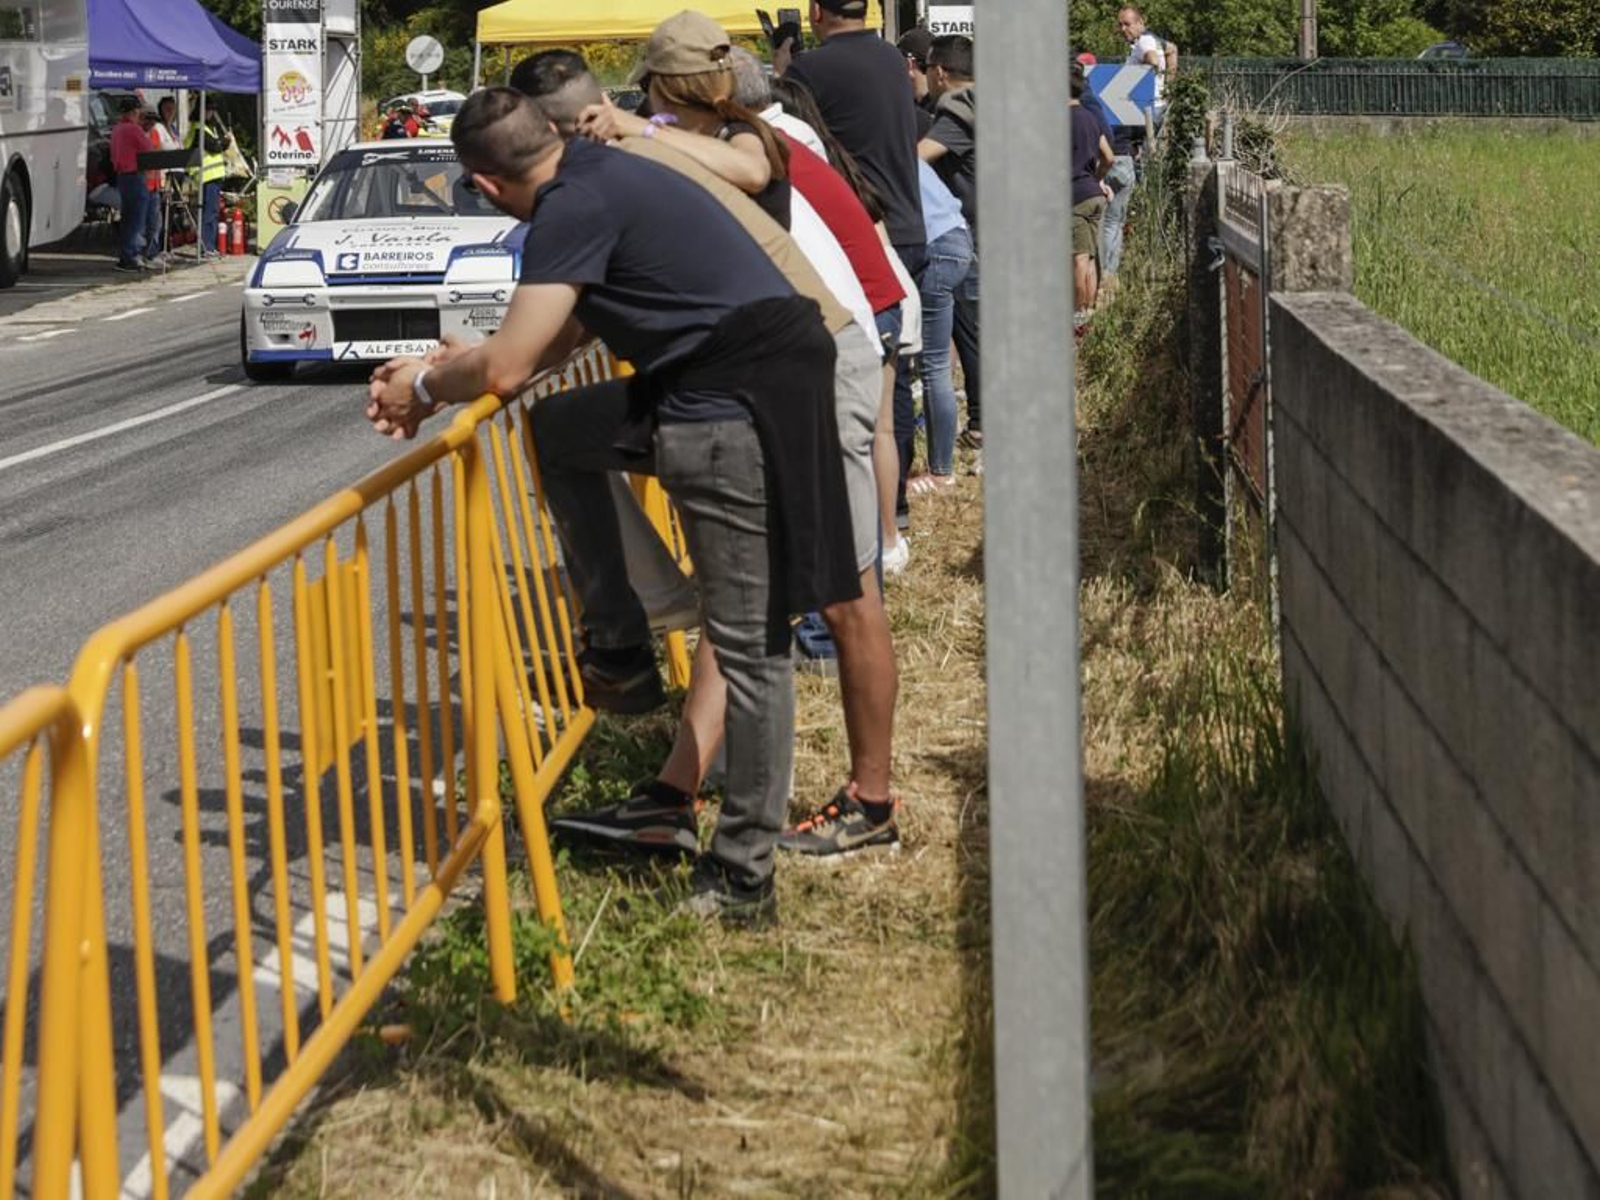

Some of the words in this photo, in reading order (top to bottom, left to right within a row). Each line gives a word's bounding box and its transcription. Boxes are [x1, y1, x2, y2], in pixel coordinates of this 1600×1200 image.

[269, 0, 319, 10] OURENSE
[268, 38, 318, 51] STARK
[363, 251, 435, 261] BARREIROS
